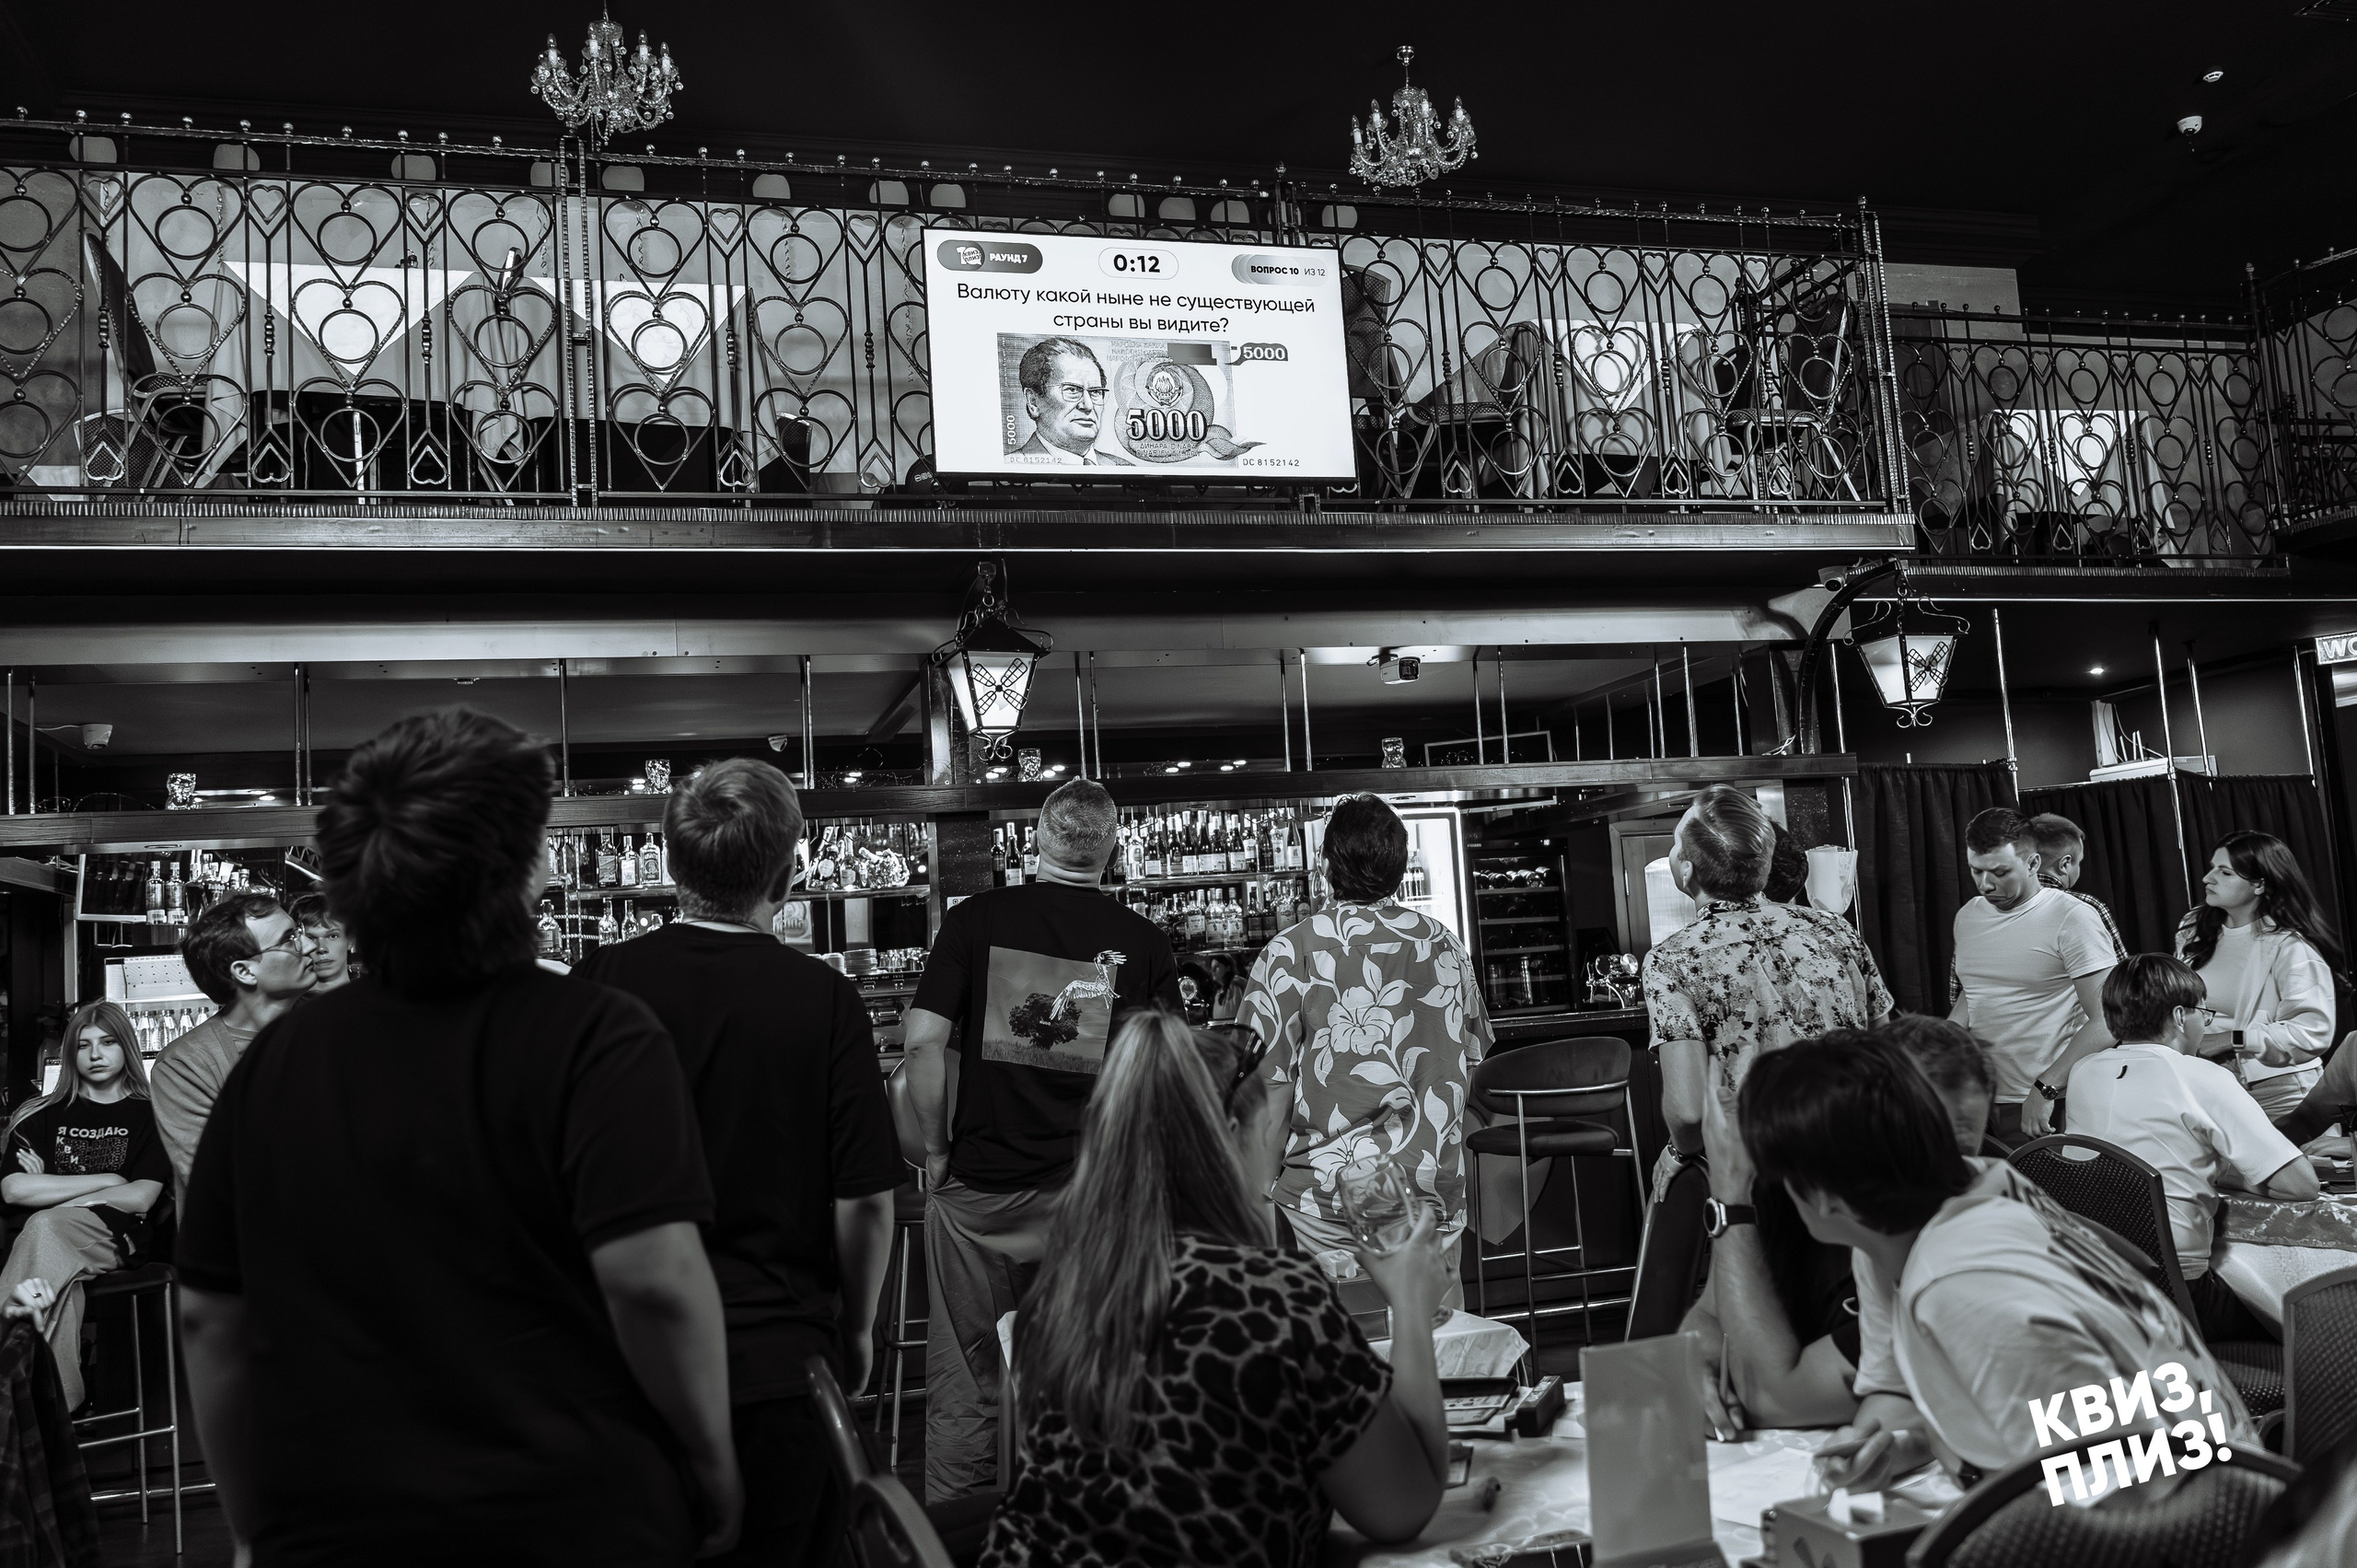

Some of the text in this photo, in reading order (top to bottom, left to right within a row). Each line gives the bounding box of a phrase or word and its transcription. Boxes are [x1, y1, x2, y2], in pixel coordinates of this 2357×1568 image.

[989, 253, 1022, 263] РАУНД
[1113, 254, 1160, 273] 0:12
[1250, 265, 1288, 274] ВОПРОС
[1304, 268, 1326, 276] ИЗ 12
[958, 283, 1315, 314] Валюту какой ныне не существующей
[1053, 315, 1229, 333] страны вы видите?
[1243, 347, 1285, 360] 5000
[1006, 414, 1016, 445] 5000
[1126, 408, 1208, 442] 5000
[58, 1126, 129, 1139] Я СОЗДАЮ
